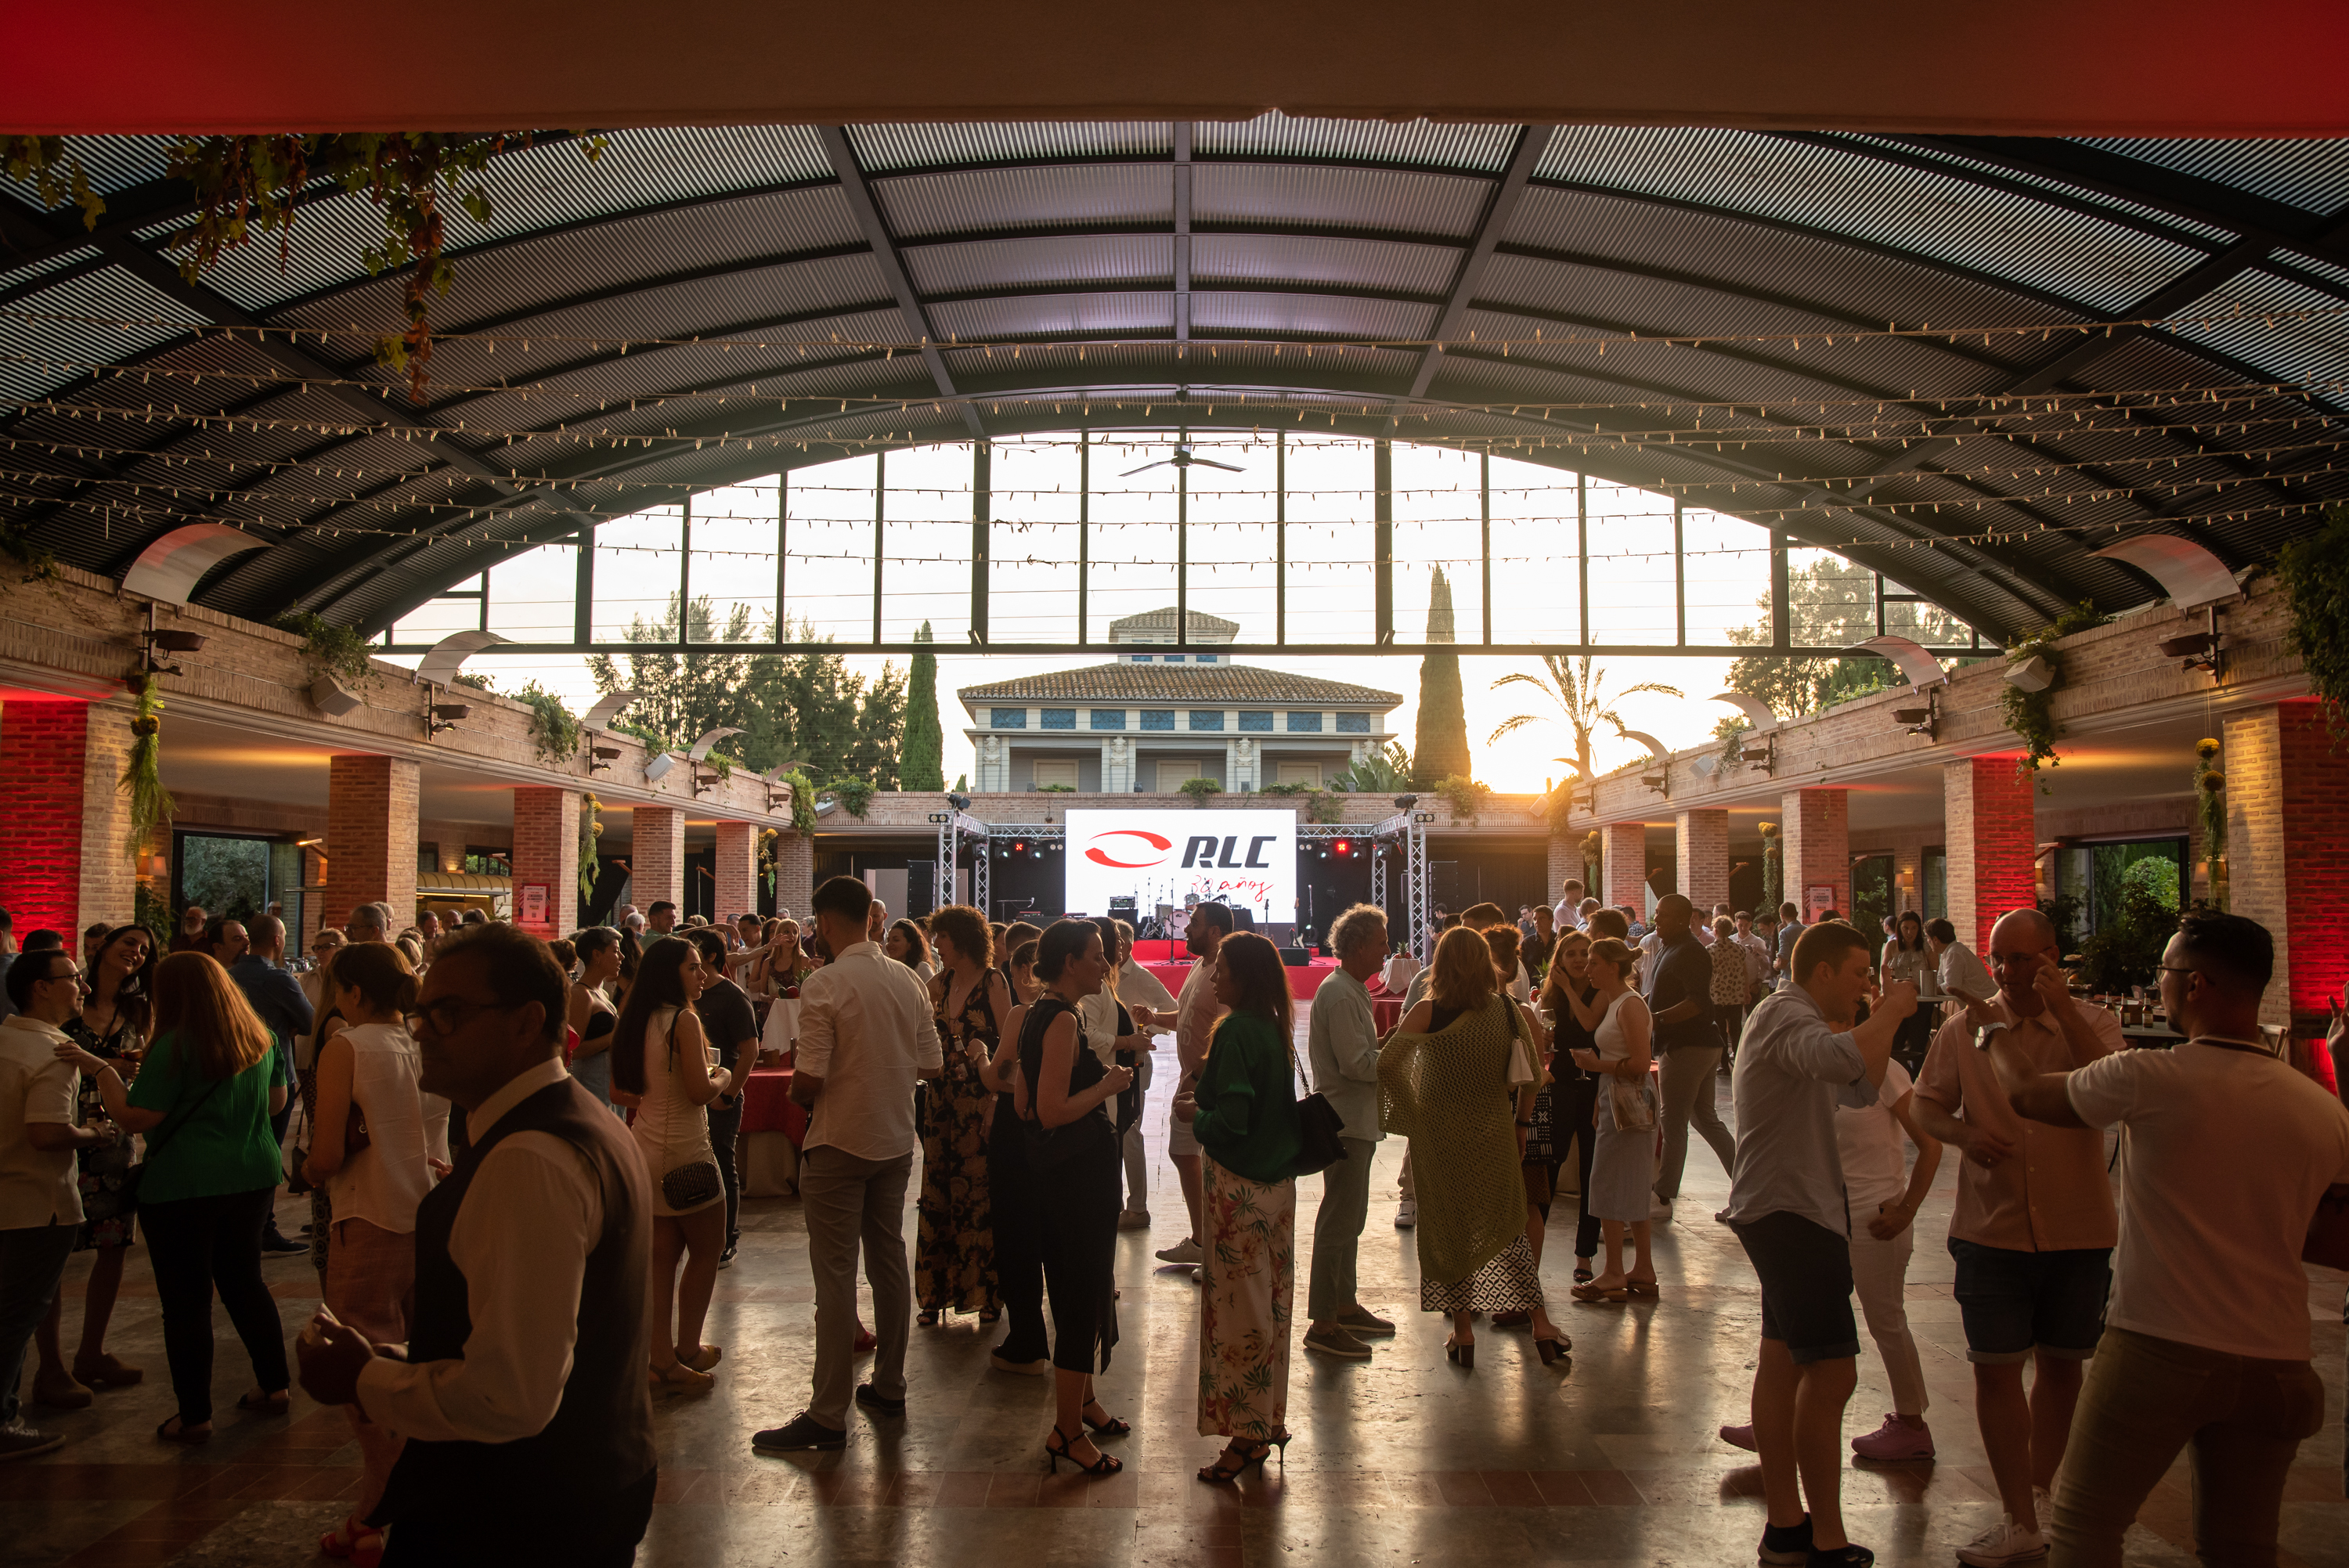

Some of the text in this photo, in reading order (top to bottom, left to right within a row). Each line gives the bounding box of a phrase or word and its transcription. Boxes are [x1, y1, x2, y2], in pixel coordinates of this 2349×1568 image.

[1181, 836, 1276, 868] RLC
[1187, 875, 1274, 902] 30 años
